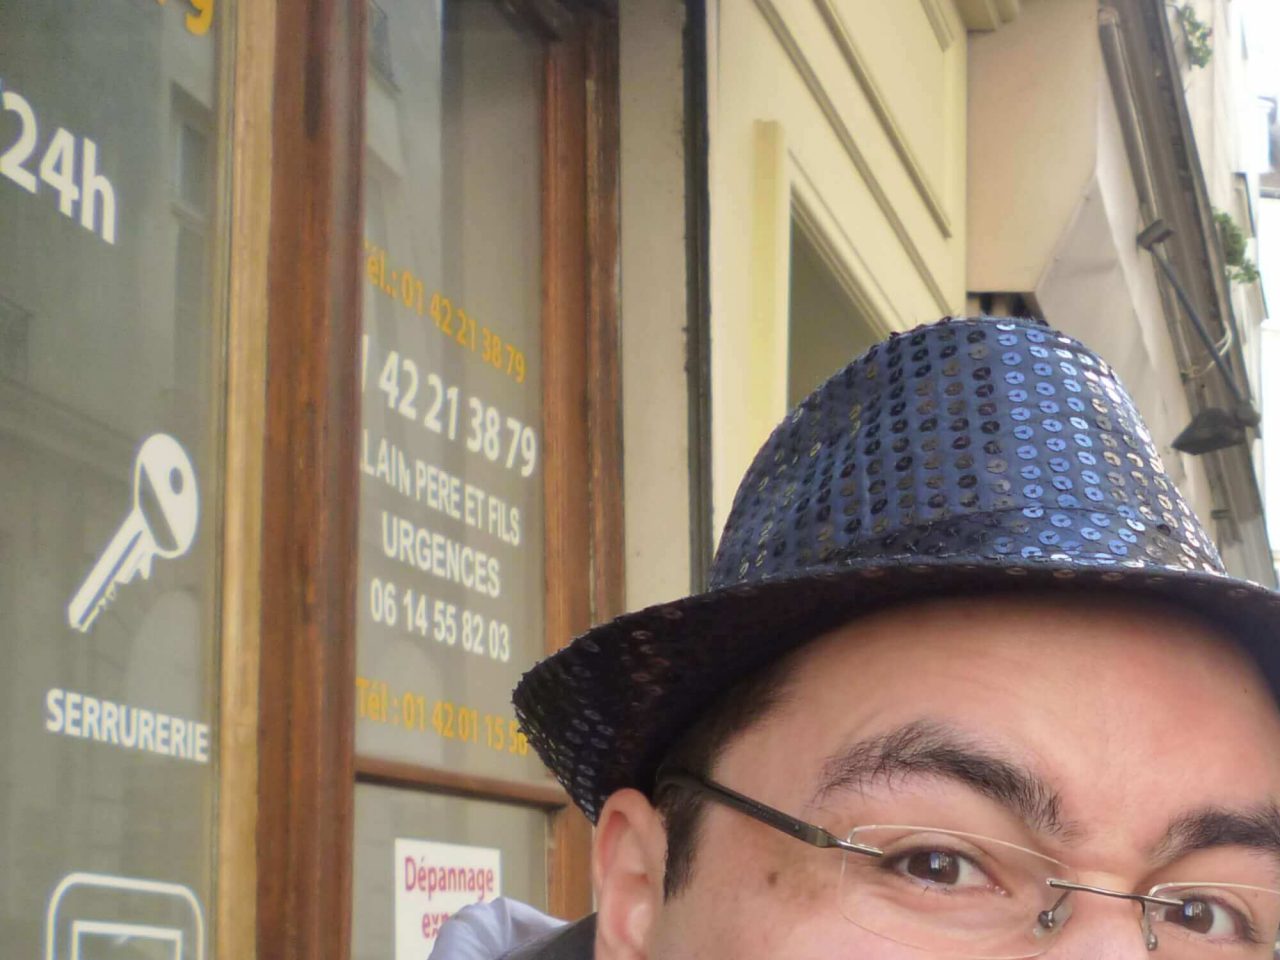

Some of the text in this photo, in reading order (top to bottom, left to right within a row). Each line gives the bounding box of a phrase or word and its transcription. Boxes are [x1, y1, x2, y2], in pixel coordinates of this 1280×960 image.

[0, 91, 116, 245] 24h
[402, 271, 424, 316] 01
[430, 292, 452, 337] 42
[456, 308, 477, 352] 21
[505, 343, 526, 384] 79
[379, 350, 419, 420] 42
[424, 373, 459, 440] 21
[466, 396, 501, 461] 38
[505, 416, 537, 478] 79
[360, 428, 520, 547] LAIN PERE ET FILS
[382, 511, 501, 598] URGENCES
[370, 577, 510, 663] 06 14 55 82 03
[46, 687, 210, 764] SERRURERIE
[403, 692, 426, 734] 01
[432, 702, 455, 741] 42
[458, 707, 479, 744] 01
[485, 714, 505, 751] 15
[405, 856, 495, 904] Dépannage
